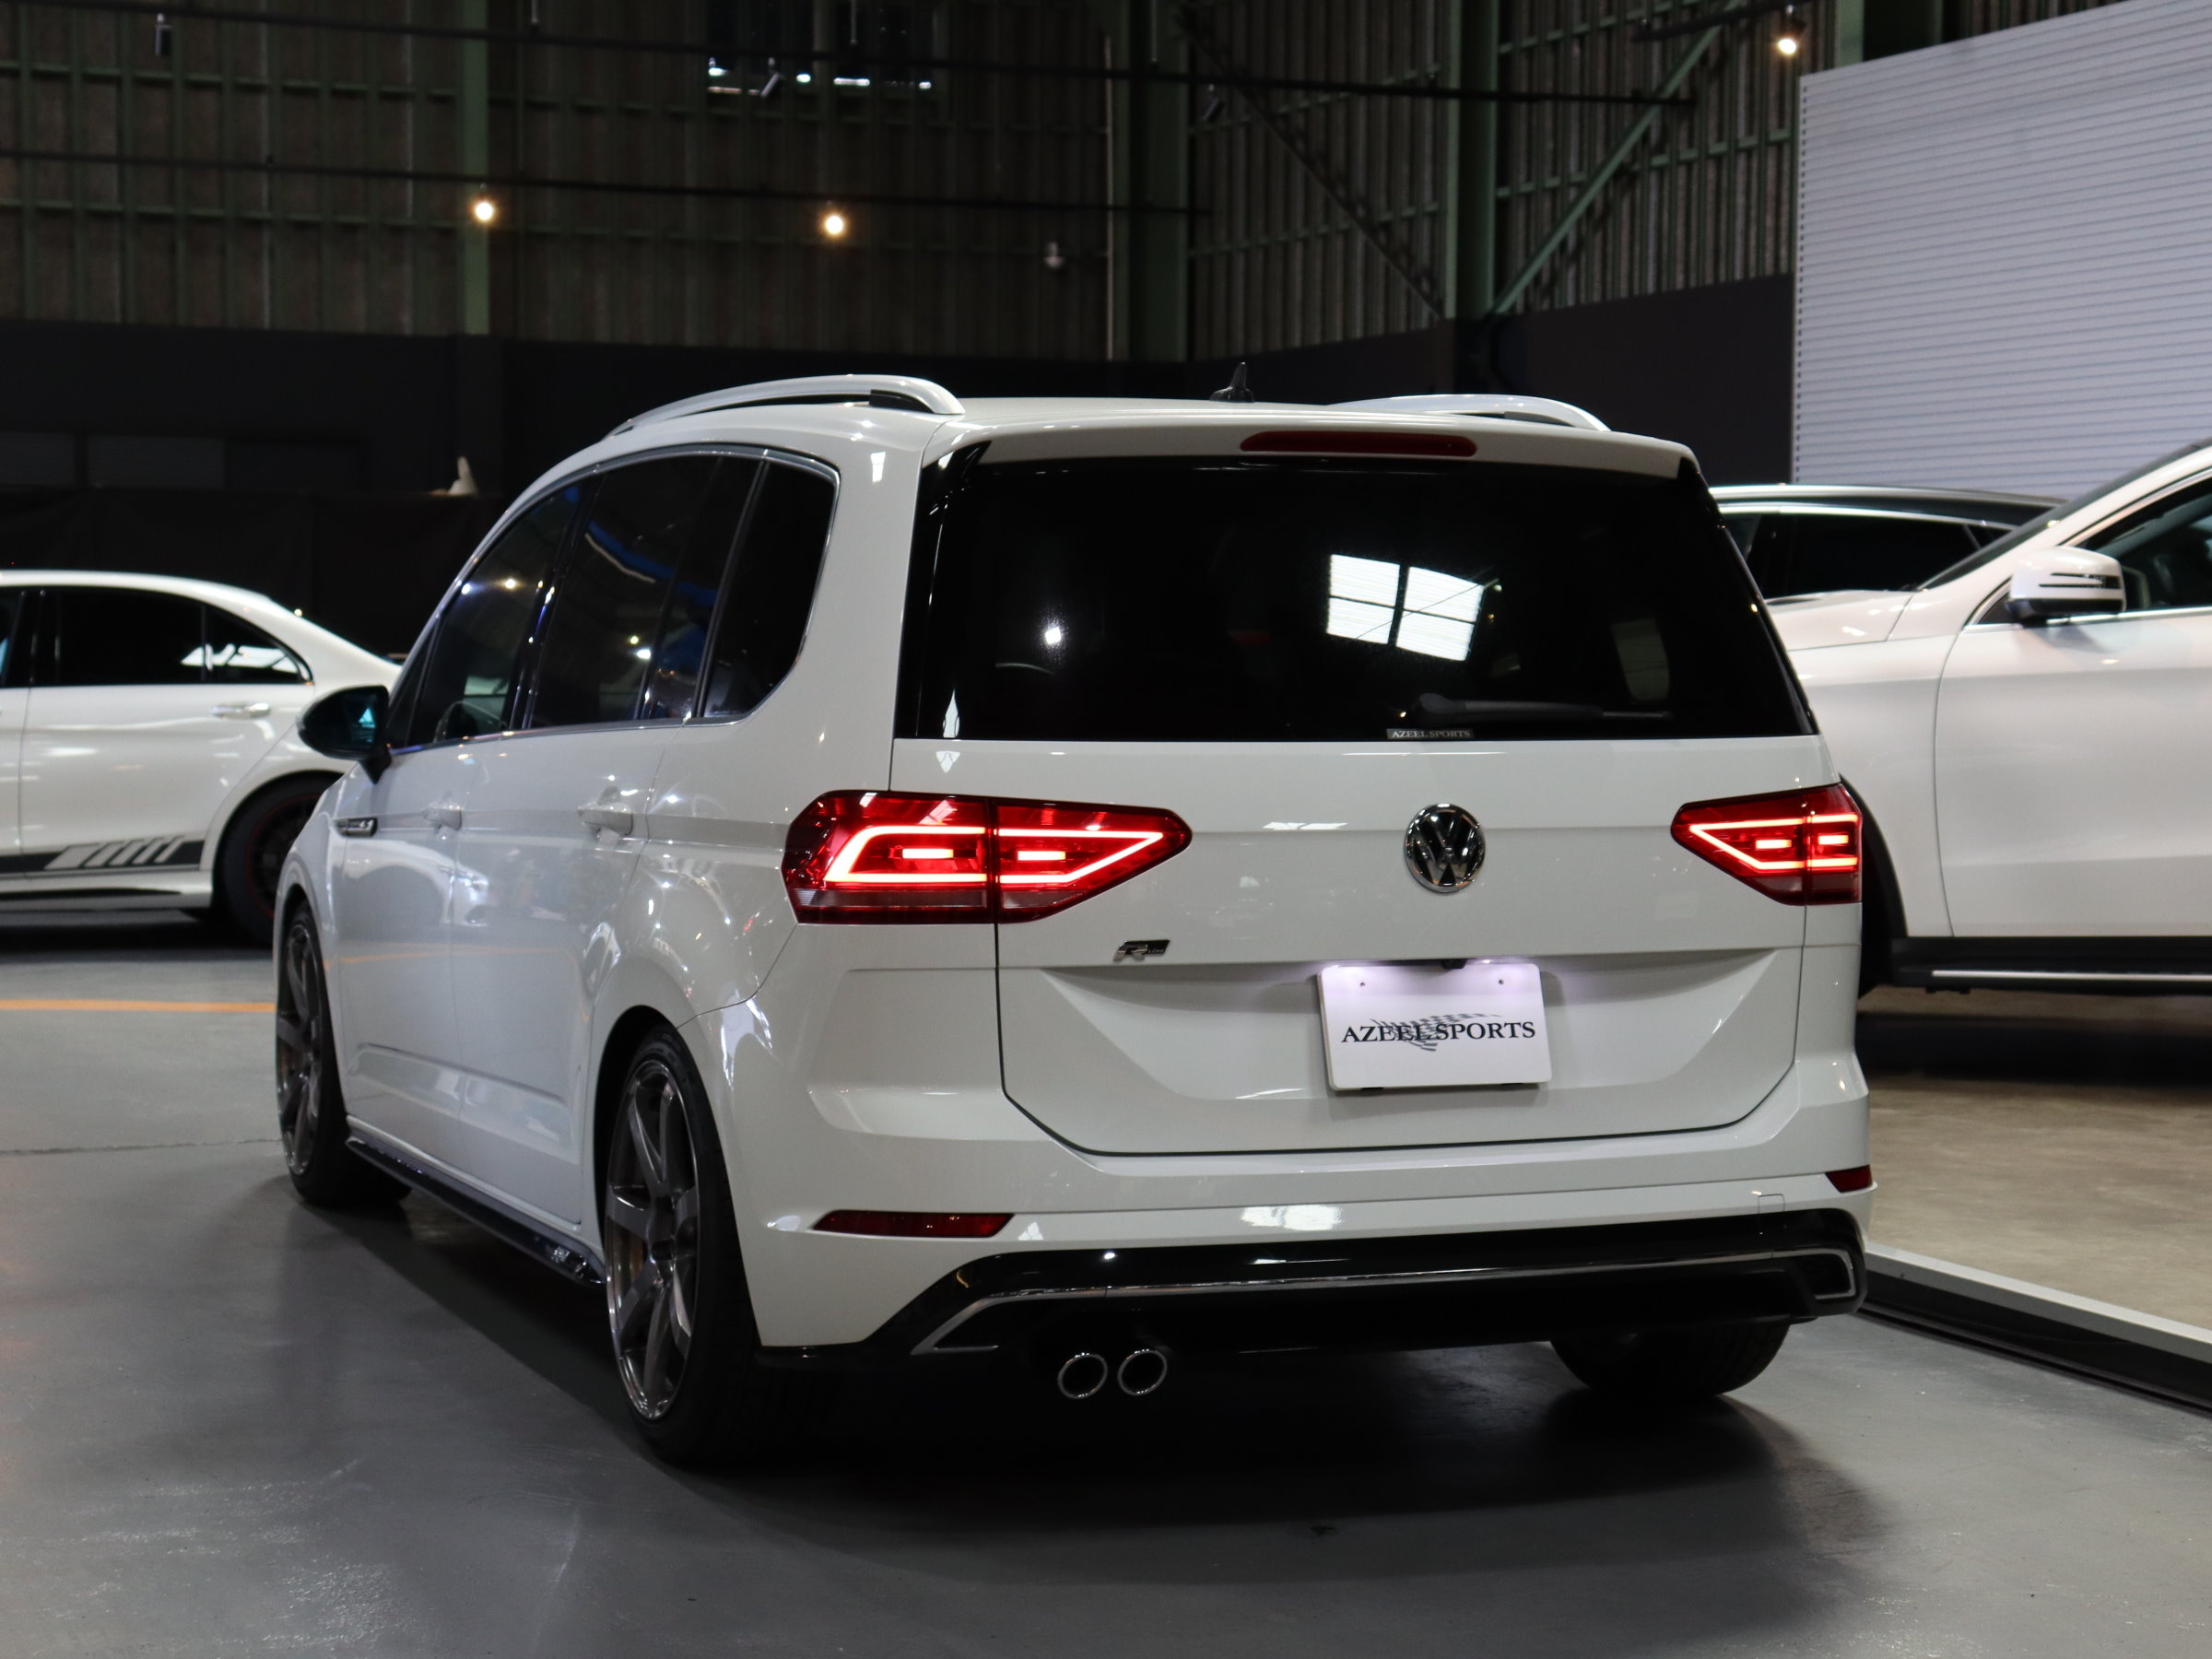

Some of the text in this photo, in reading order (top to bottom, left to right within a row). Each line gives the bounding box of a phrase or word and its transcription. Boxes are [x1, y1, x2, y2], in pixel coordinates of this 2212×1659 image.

[1392, 729, 1471, 738] AZEEL SPORTS
[1407, 806, 1483, 889] VW
[1341, 1021, 1536, 1042] AZEEL SPORTS
